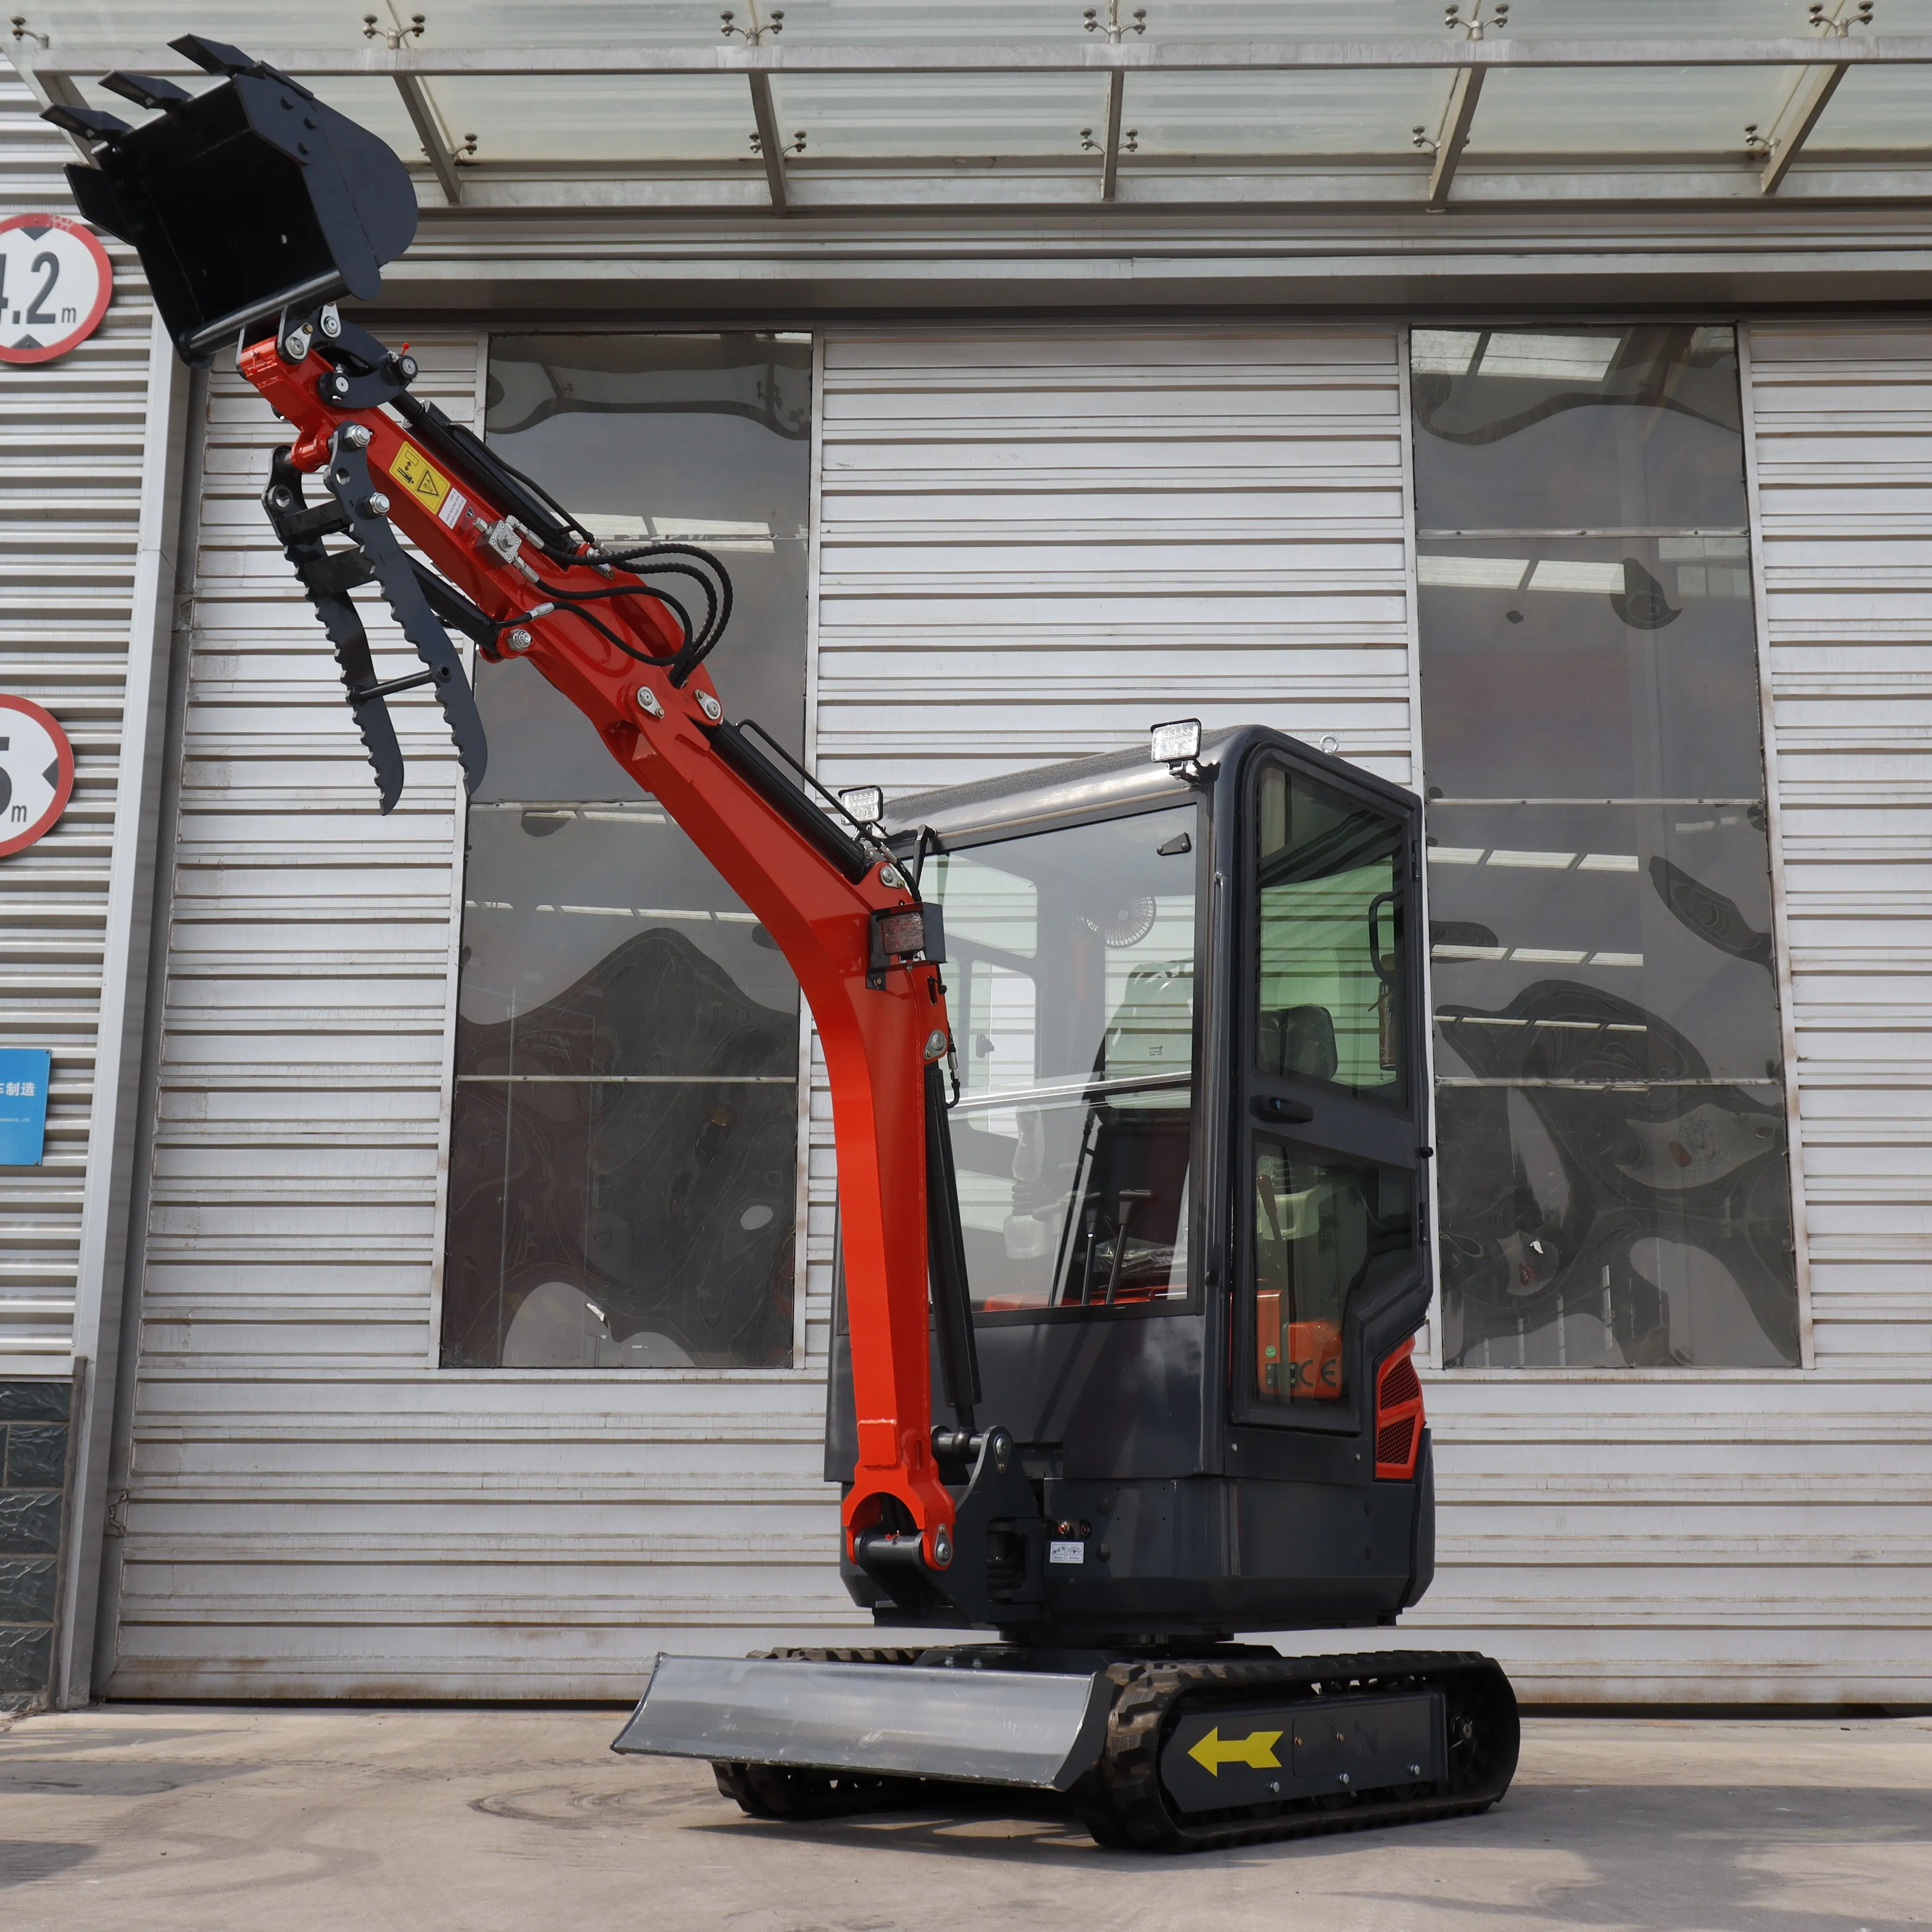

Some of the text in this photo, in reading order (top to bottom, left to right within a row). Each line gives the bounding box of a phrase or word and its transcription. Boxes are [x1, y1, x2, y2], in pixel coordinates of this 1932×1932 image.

[0, 251, 76, 324] .2 m
[11, 805, 27, 822] m
[1299, 1359, 1336, 1387] CE
